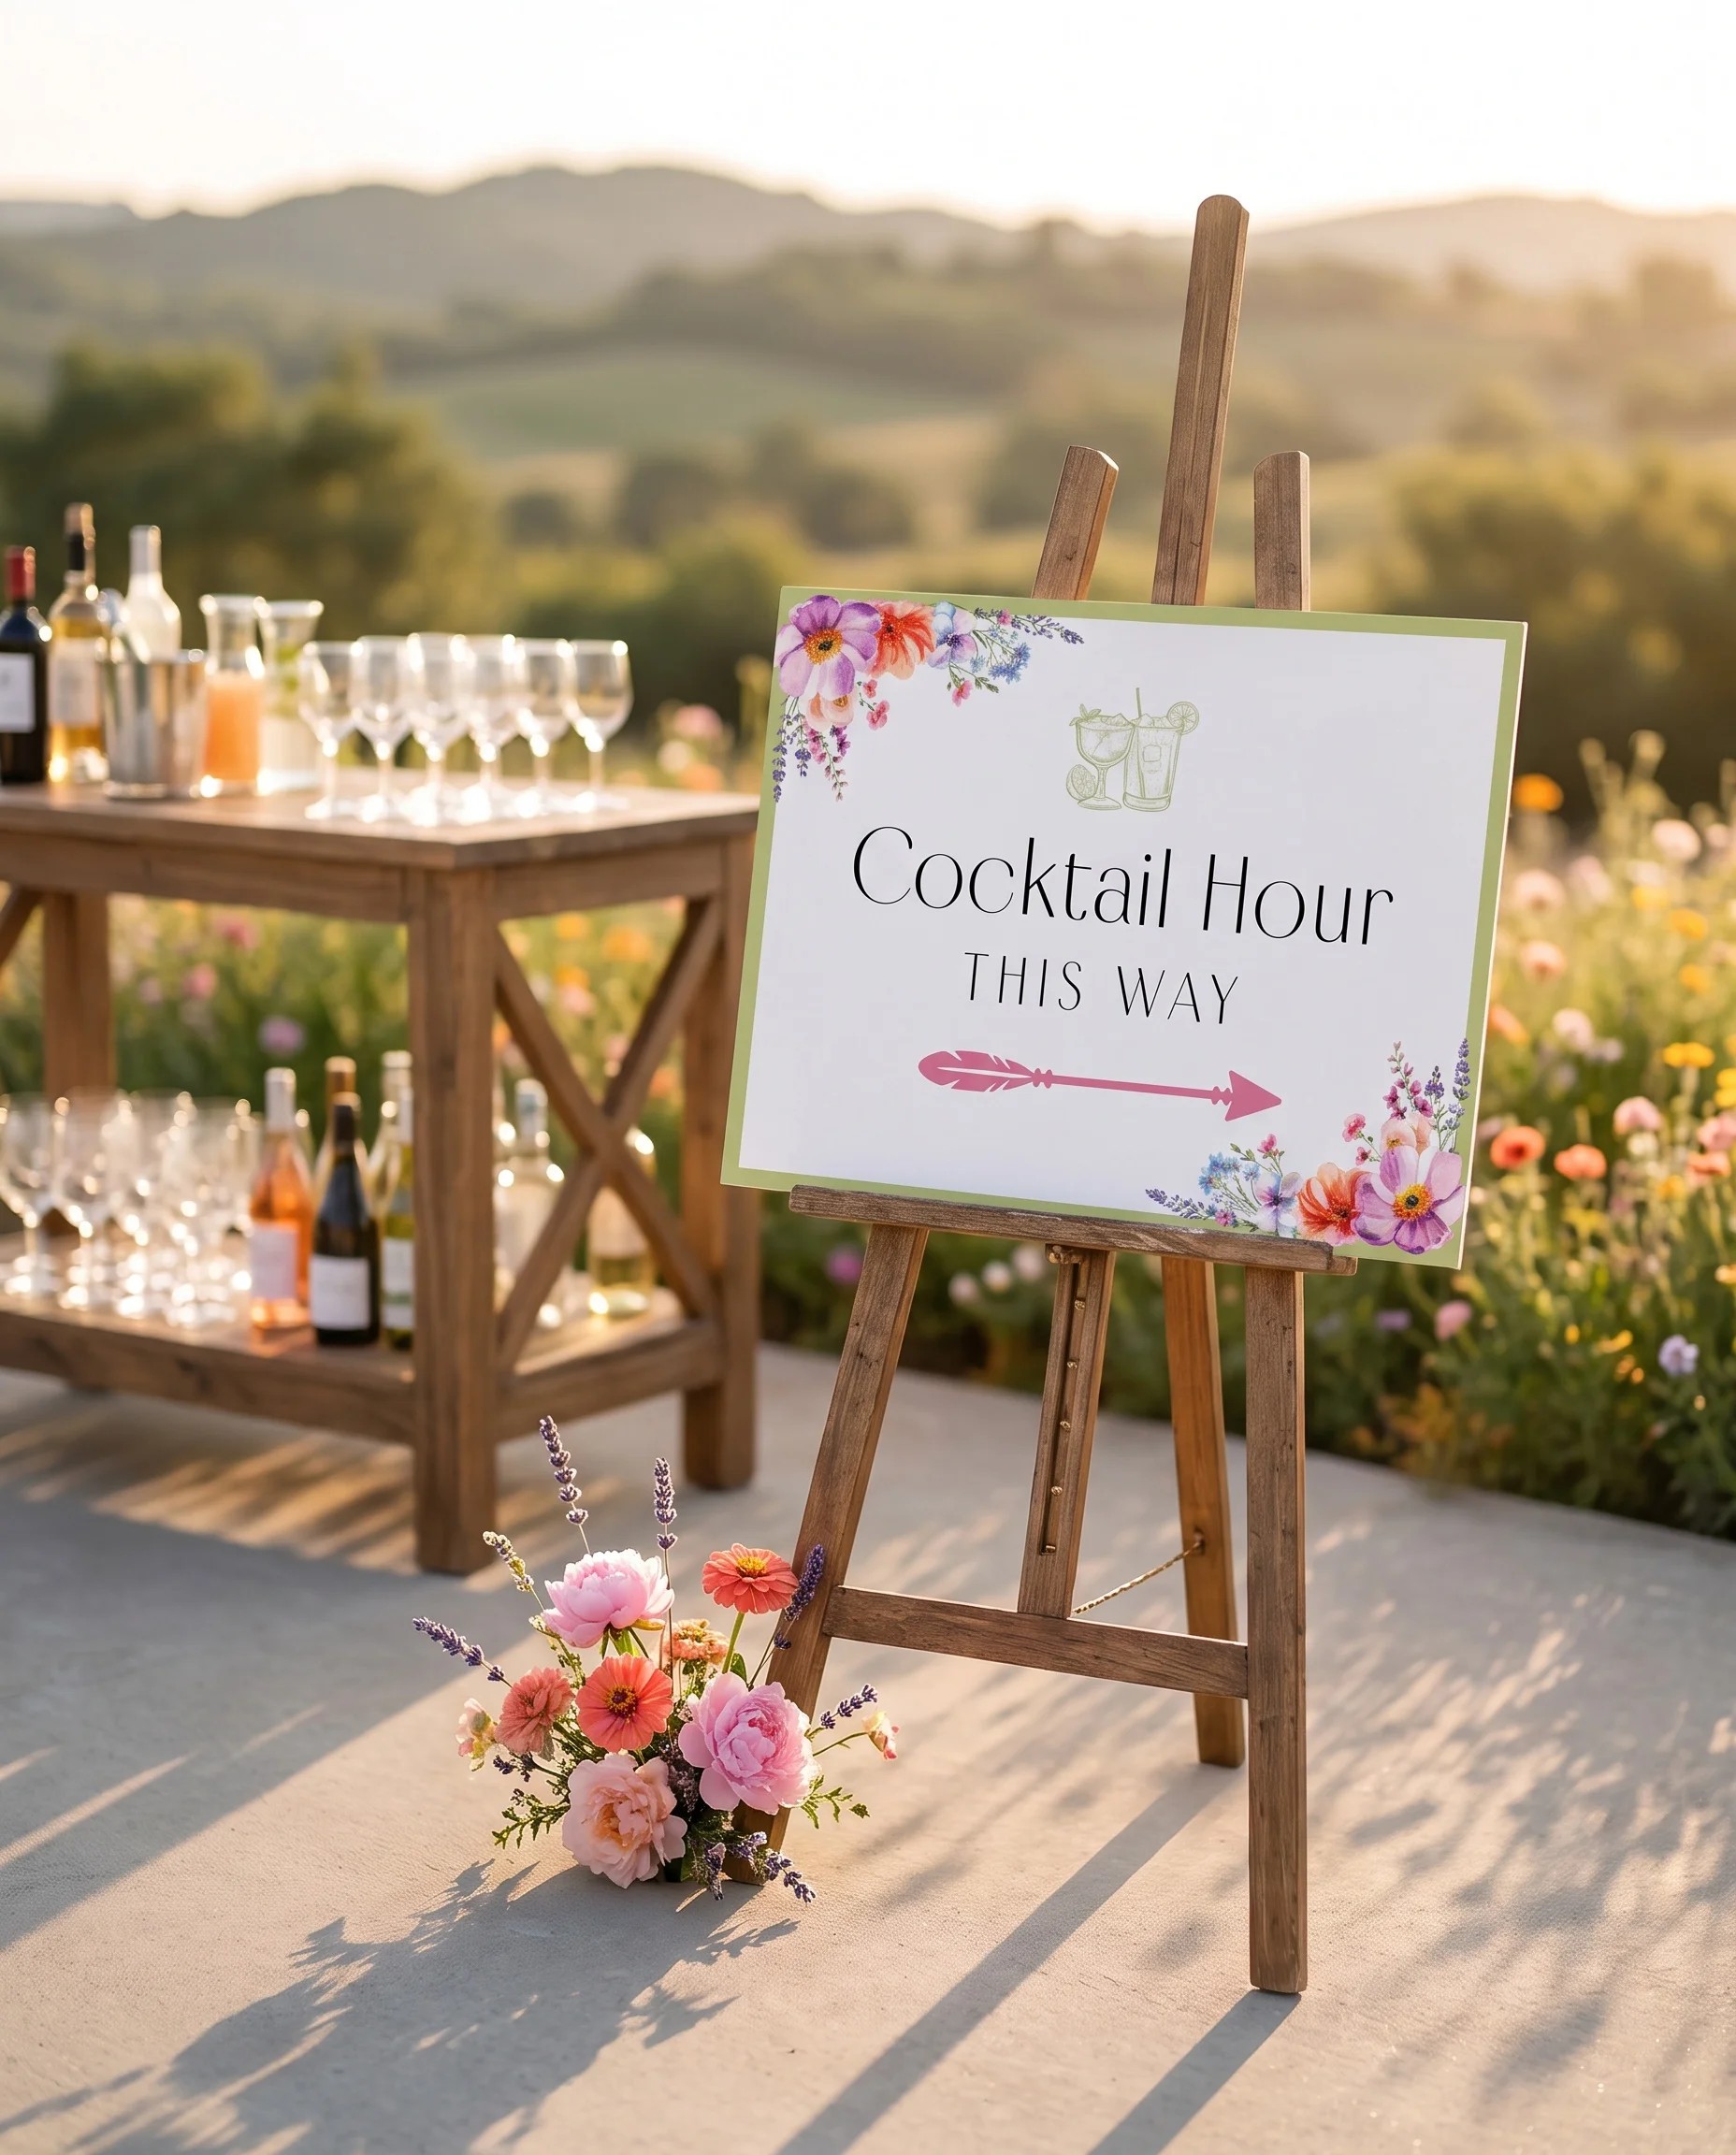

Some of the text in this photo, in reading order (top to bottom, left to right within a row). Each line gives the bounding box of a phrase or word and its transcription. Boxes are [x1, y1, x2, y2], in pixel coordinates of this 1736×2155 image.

[854, 827, 1393, 945] Cocktail Hour
[964, 952, 1237, 1024] THIS WAY
